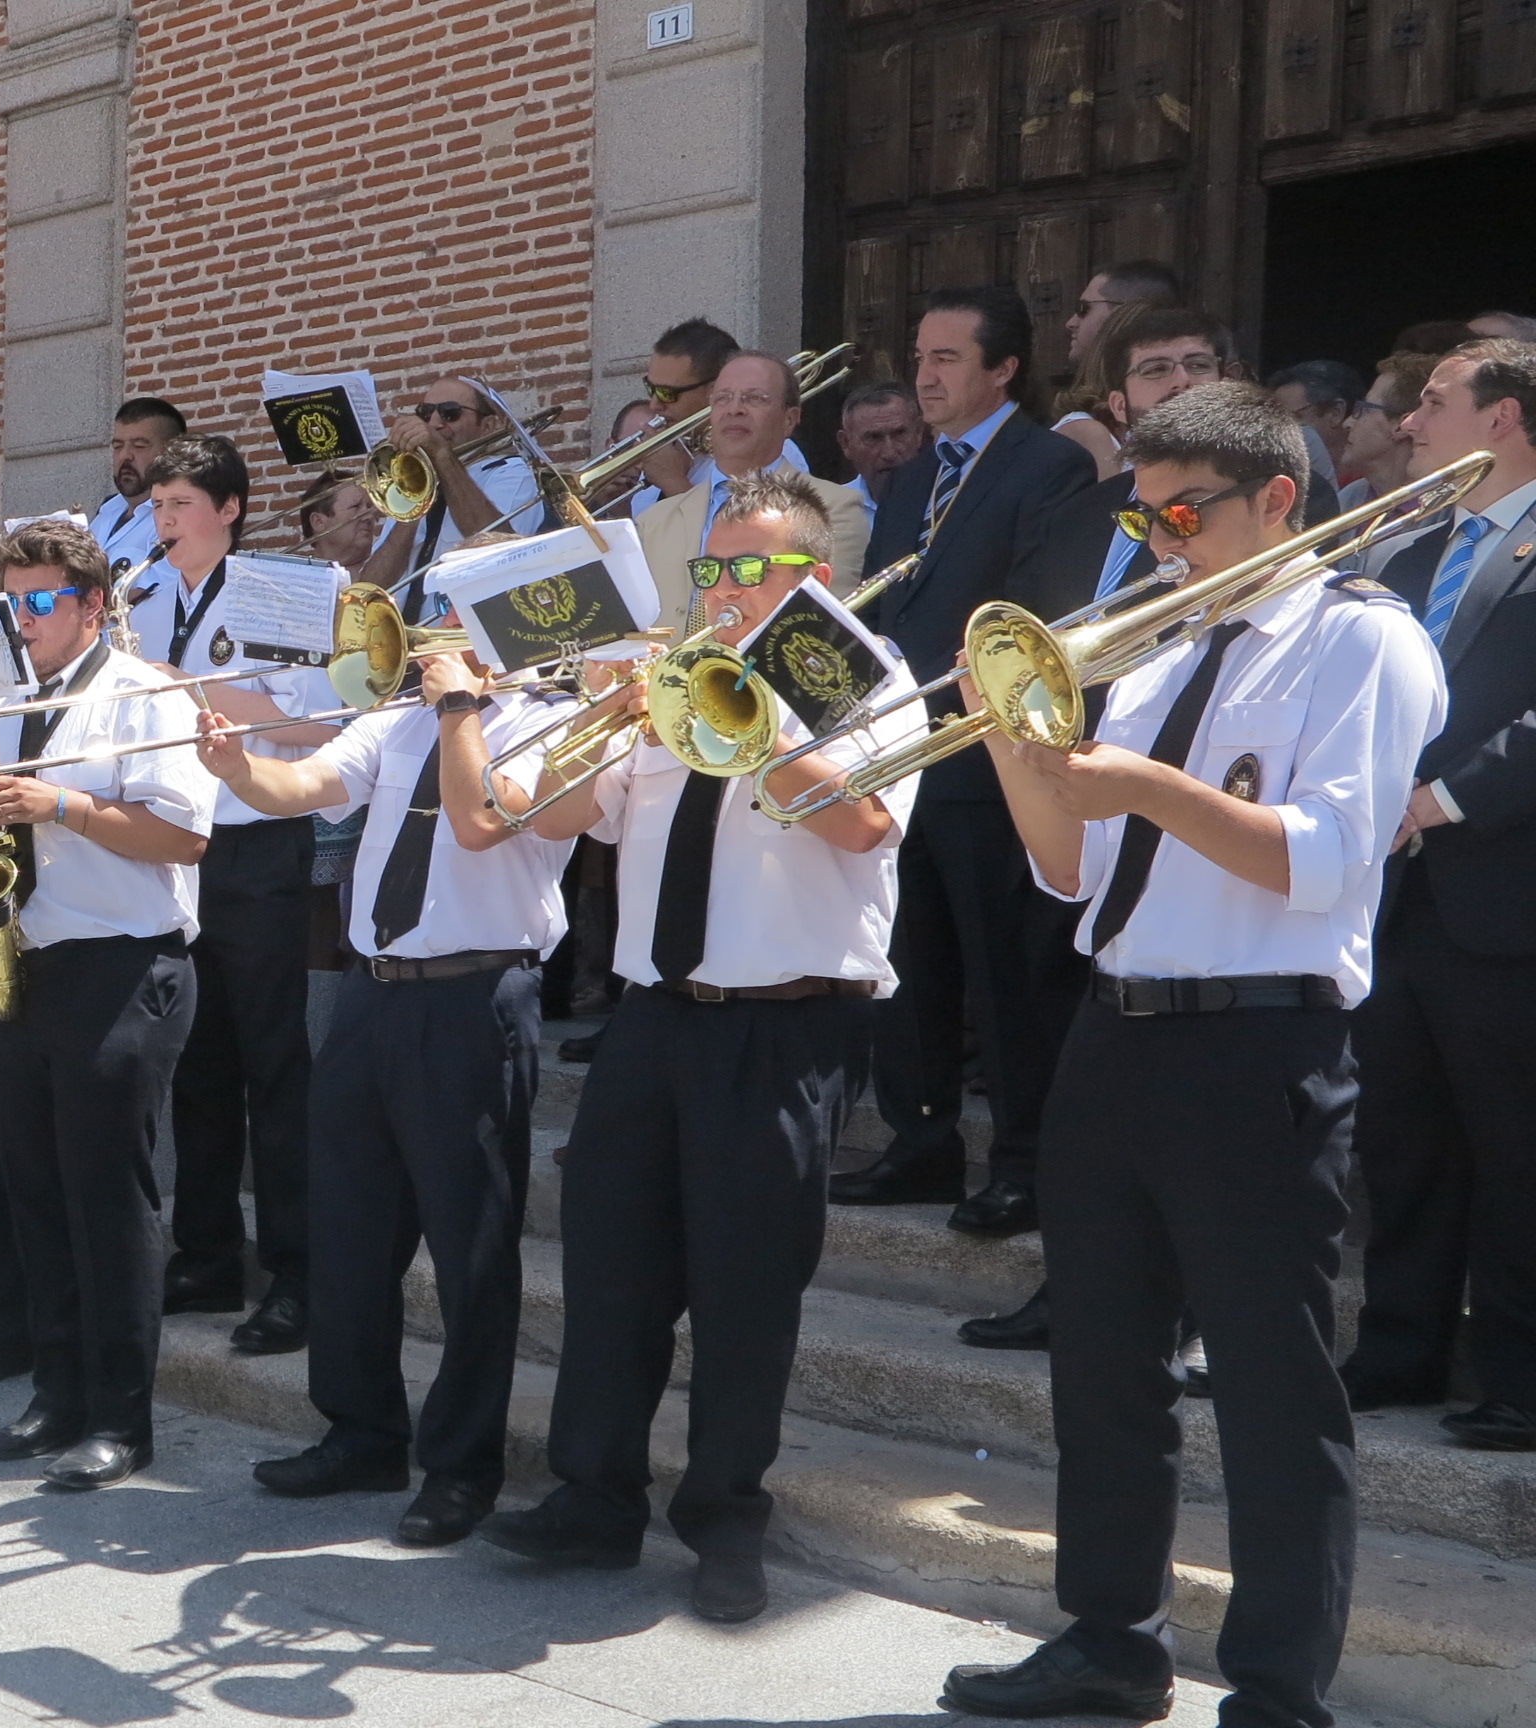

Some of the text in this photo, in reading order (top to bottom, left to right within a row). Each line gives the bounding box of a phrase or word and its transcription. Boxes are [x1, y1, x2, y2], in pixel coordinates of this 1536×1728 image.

[657, 13, 680, 39] 11
[283, 403, 341, 425] BANDA MUNICIPAL
[508, 600, 602, 643] BANDA MUNICIPAL
[765, 613, 824, 673] BANDA MUNICIPAL
[830, 682, 869, 719] AREALO
